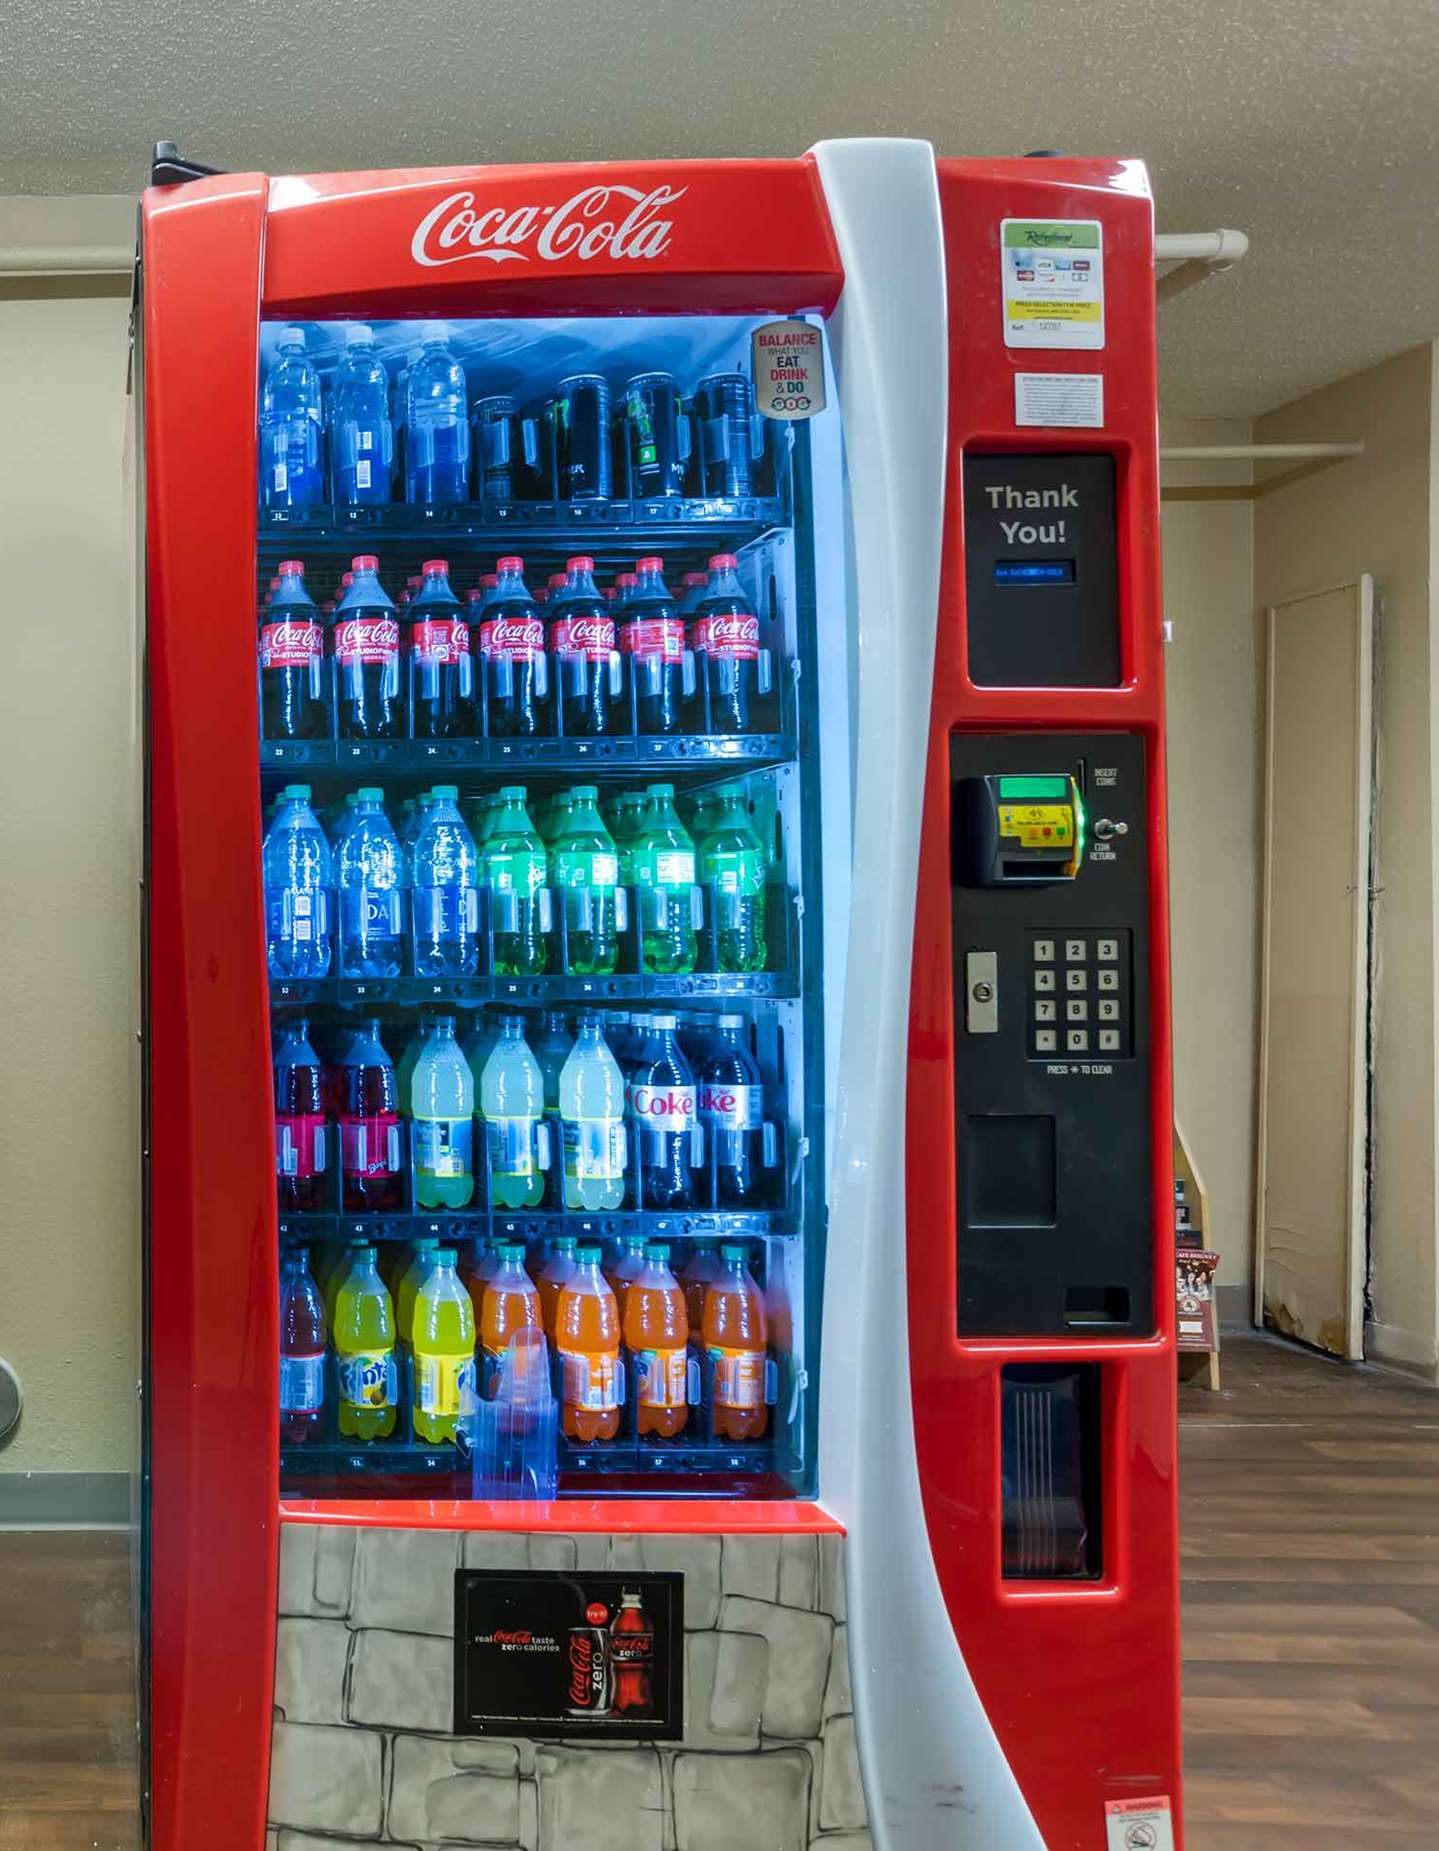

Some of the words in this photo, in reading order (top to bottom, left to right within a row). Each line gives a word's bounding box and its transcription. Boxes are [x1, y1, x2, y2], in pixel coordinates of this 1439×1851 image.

[411, 185, 689, 266] Coca-Cola
[758, 333, 817, 347] BALANCE
[777, 356, 800, 368] EAT
[770, 368, 808, 381] DRINK
[776, 382, 784, 393] &
[787, 381, 804, 393] DO
[985, 484, 1079, 509] Thank
[999, 520, 1067, 544] You!
[1094, 768, 1118, 777] INSERT
[1040, 946, 1047, 955] 1
[1072, 945, 1080, 955] 2
[1103, 945, 1112, 955] 3
[1040, 975, 1048, 984] 4
[1072, 975, 1080, 984] 5
[1103, 974, 1111, 984] 6
[1041, 1005, 1049, 1014] 7
[1072, 1005, 1080, 1014] 8
[1104, 1004, 1112, 1014] 9
[1073, 1034, 1081, 1044] 0
[1047, 1065, 1068, 1074] PRESS
[1081, 1065, 1090, 1074] TO
[634, 1089, 693, 1116] Coke
[475, 1635, 493, 1643] real
[524, 1643, 560, 1652] calories
[569, 1635, 592, 1705] Coca-Cola
[592, 1652, 604, 1691] zero
